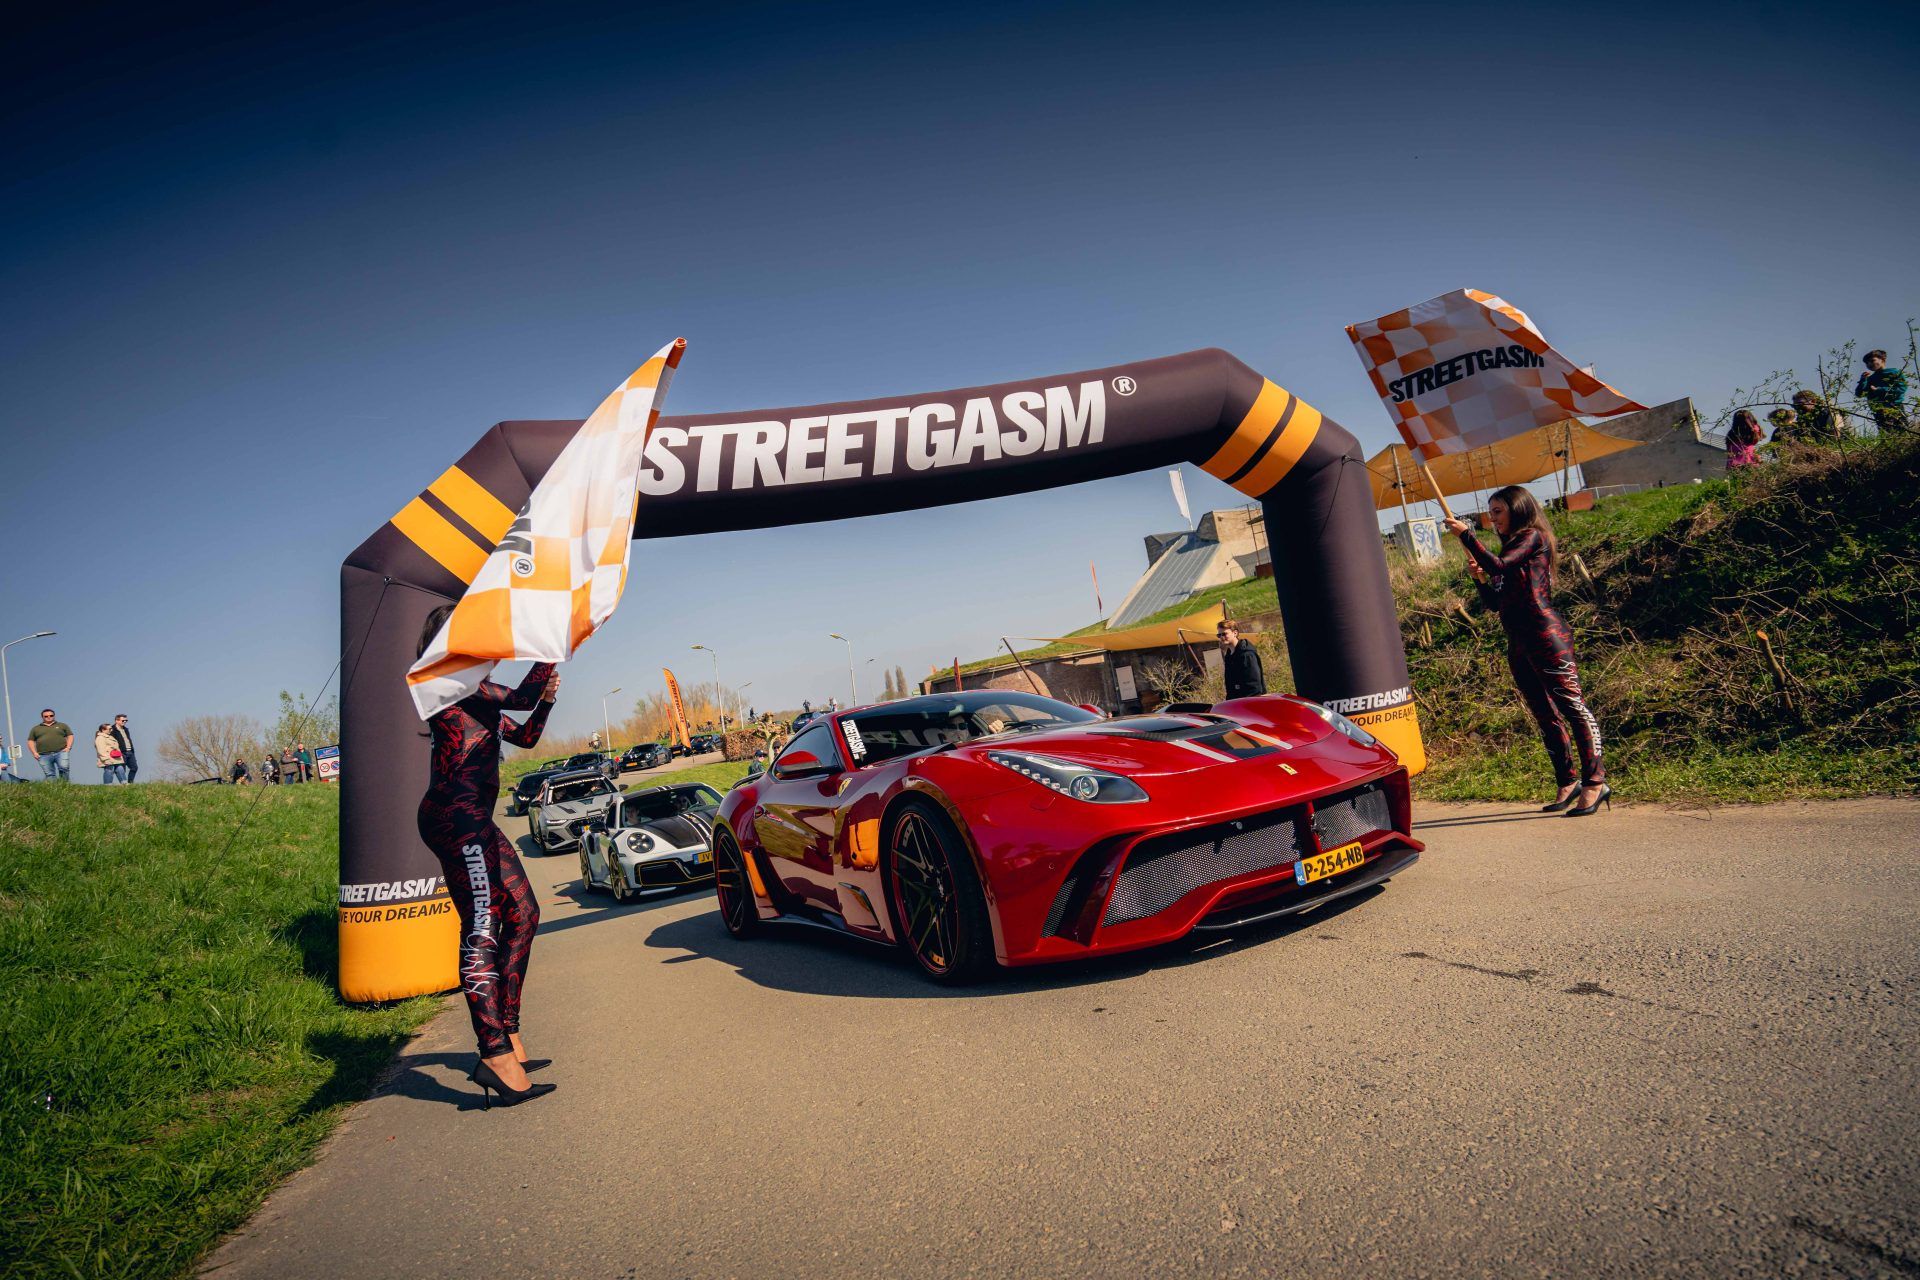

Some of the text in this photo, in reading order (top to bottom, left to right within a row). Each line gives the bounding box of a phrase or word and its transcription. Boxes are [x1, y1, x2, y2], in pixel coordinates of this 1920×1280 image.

[1389, 345, 1545, 403] STREETGASM
[1323, 687, 1410, 713] STREETGASM
[1304, 846, 1363, 881] P-254-NB
[462, 844, 492, 937] STREETGASM
[350, 911, 382, 923] YOUR
[386, 901, 451, 921] DREAMS
